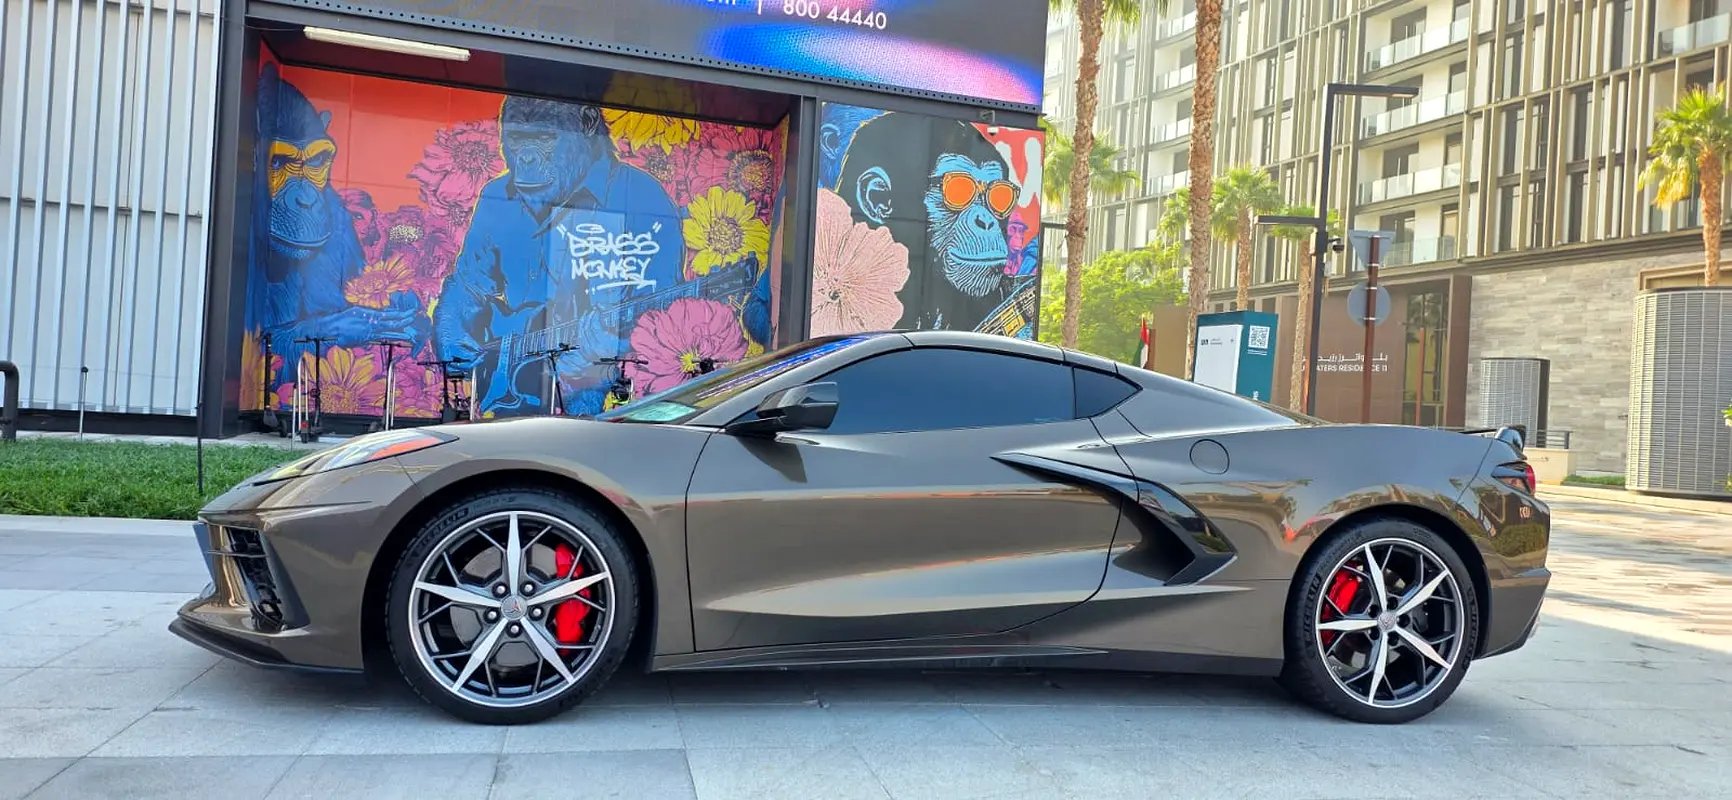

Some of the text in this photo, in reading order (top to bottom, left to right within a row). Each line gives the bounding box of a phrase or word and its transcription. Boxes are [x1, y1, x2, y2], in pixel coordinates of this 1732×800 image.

[783, 0, 887, 30] 800 44440
[571, 256, 651, 281] MONKEY
